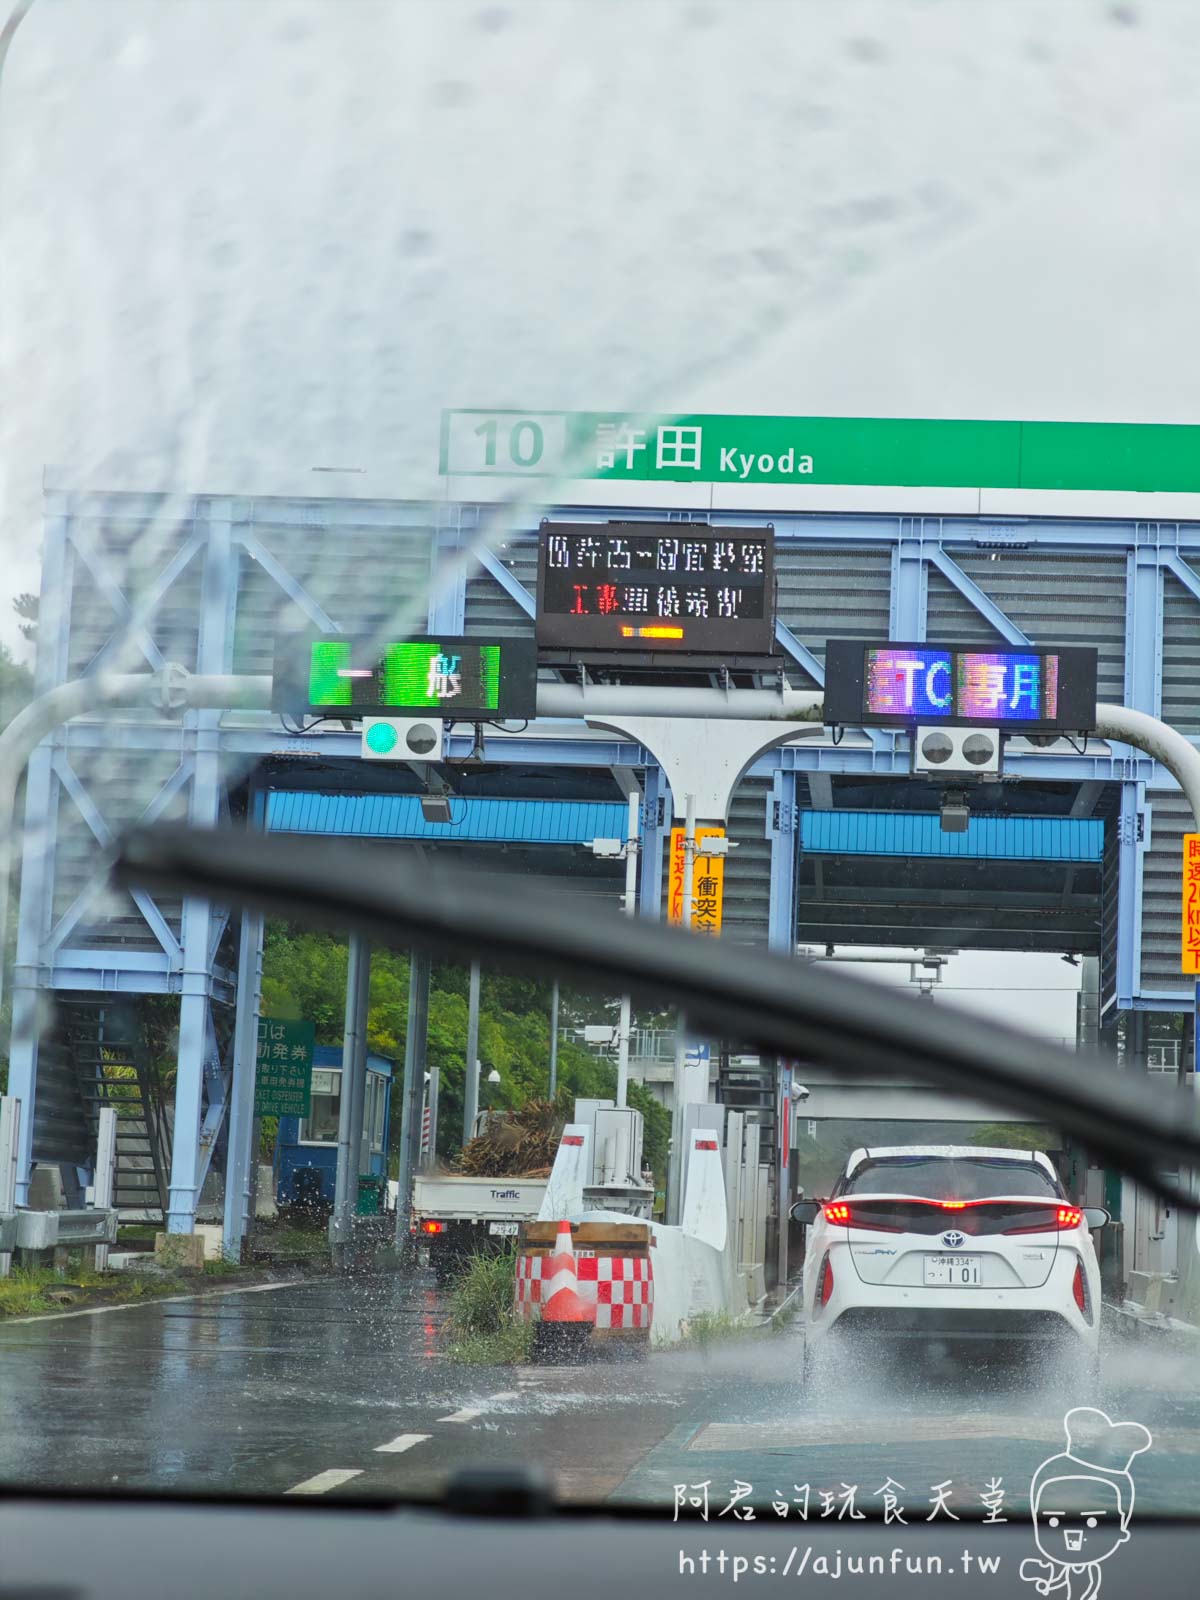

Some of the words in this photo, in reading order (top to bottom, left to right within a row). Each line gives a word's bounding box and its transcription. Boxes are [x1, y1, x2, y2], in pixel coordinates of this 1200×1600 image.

[474, 419, 544, 468] 10
[595, 424, 703, 470] 許田
[719, 448, 814, 479] Kyoda
[490, 1189, 520, 1200] Traffic
